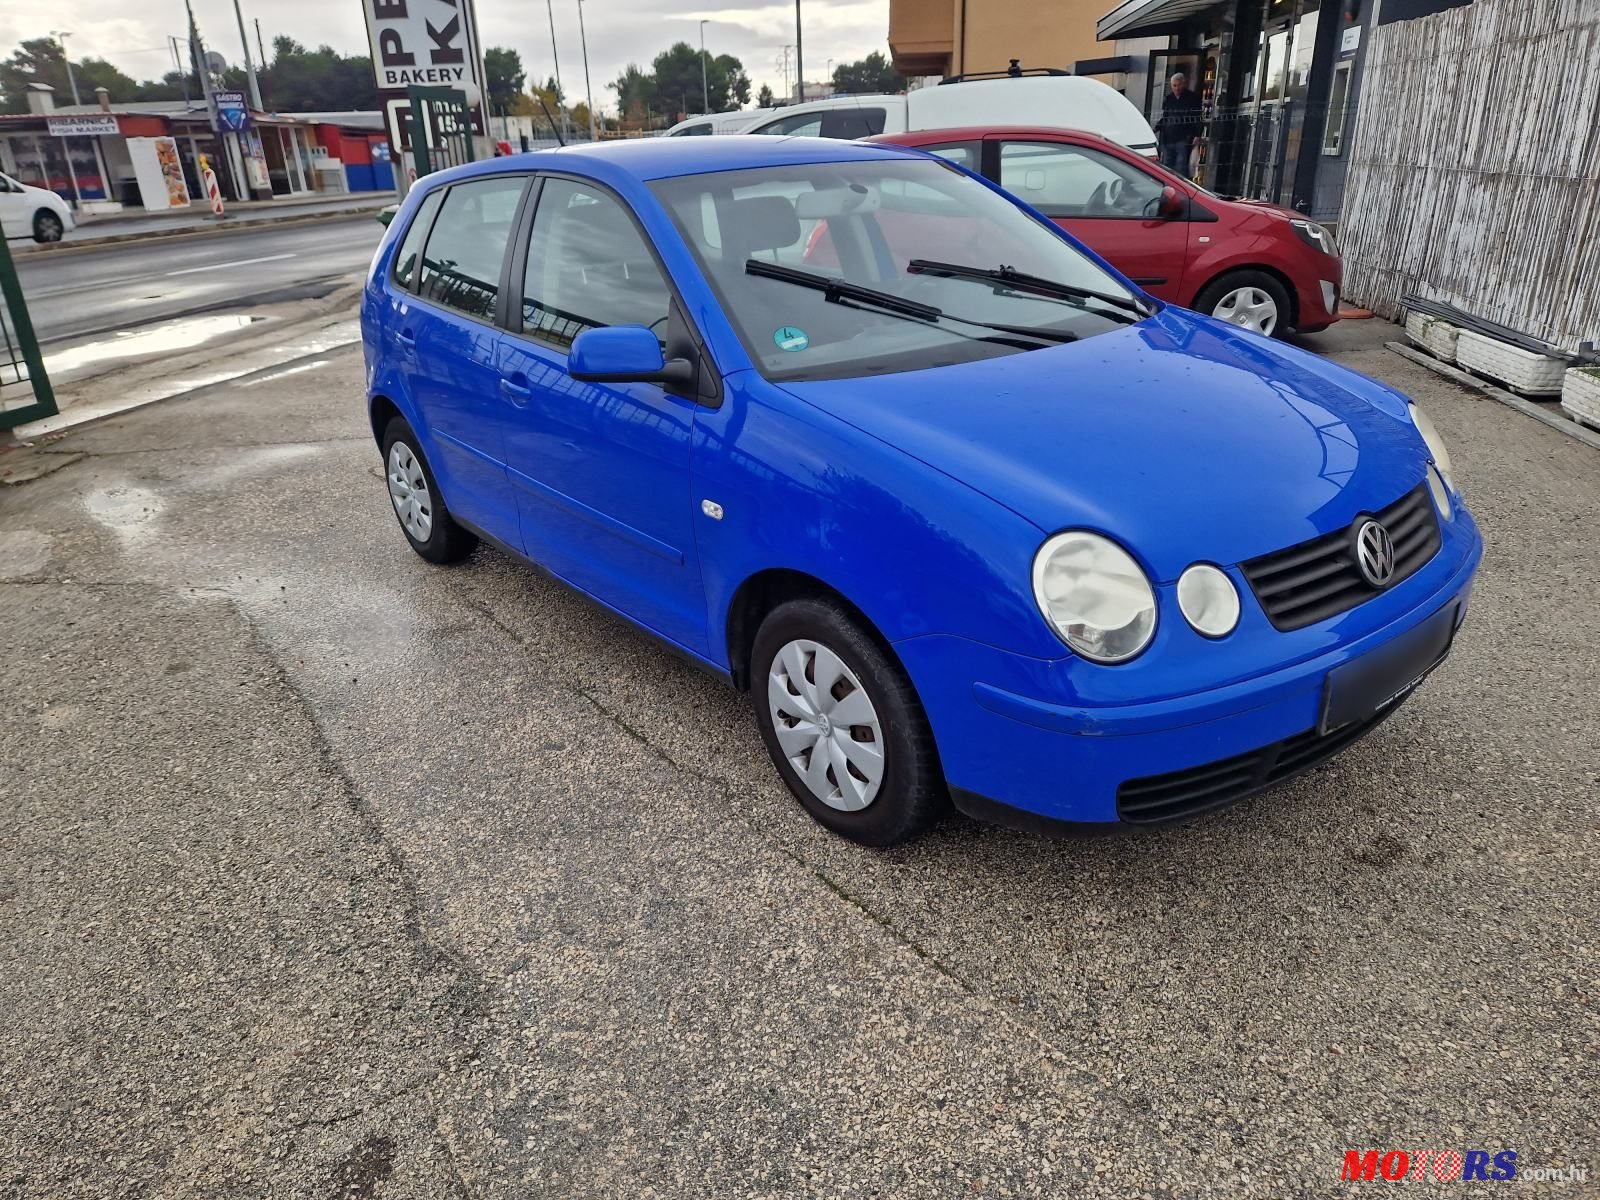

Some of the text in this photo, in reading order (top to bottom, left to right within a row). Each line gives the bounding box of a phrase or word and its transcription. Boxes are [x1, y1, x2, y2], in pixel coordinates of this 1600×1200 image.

[385, 67, 464, 84] BAKERY
[216, 93, 242, 102] GASTRO
[76, 125, 116, 133] MARKET
[783, 327, 795, 339] 4
